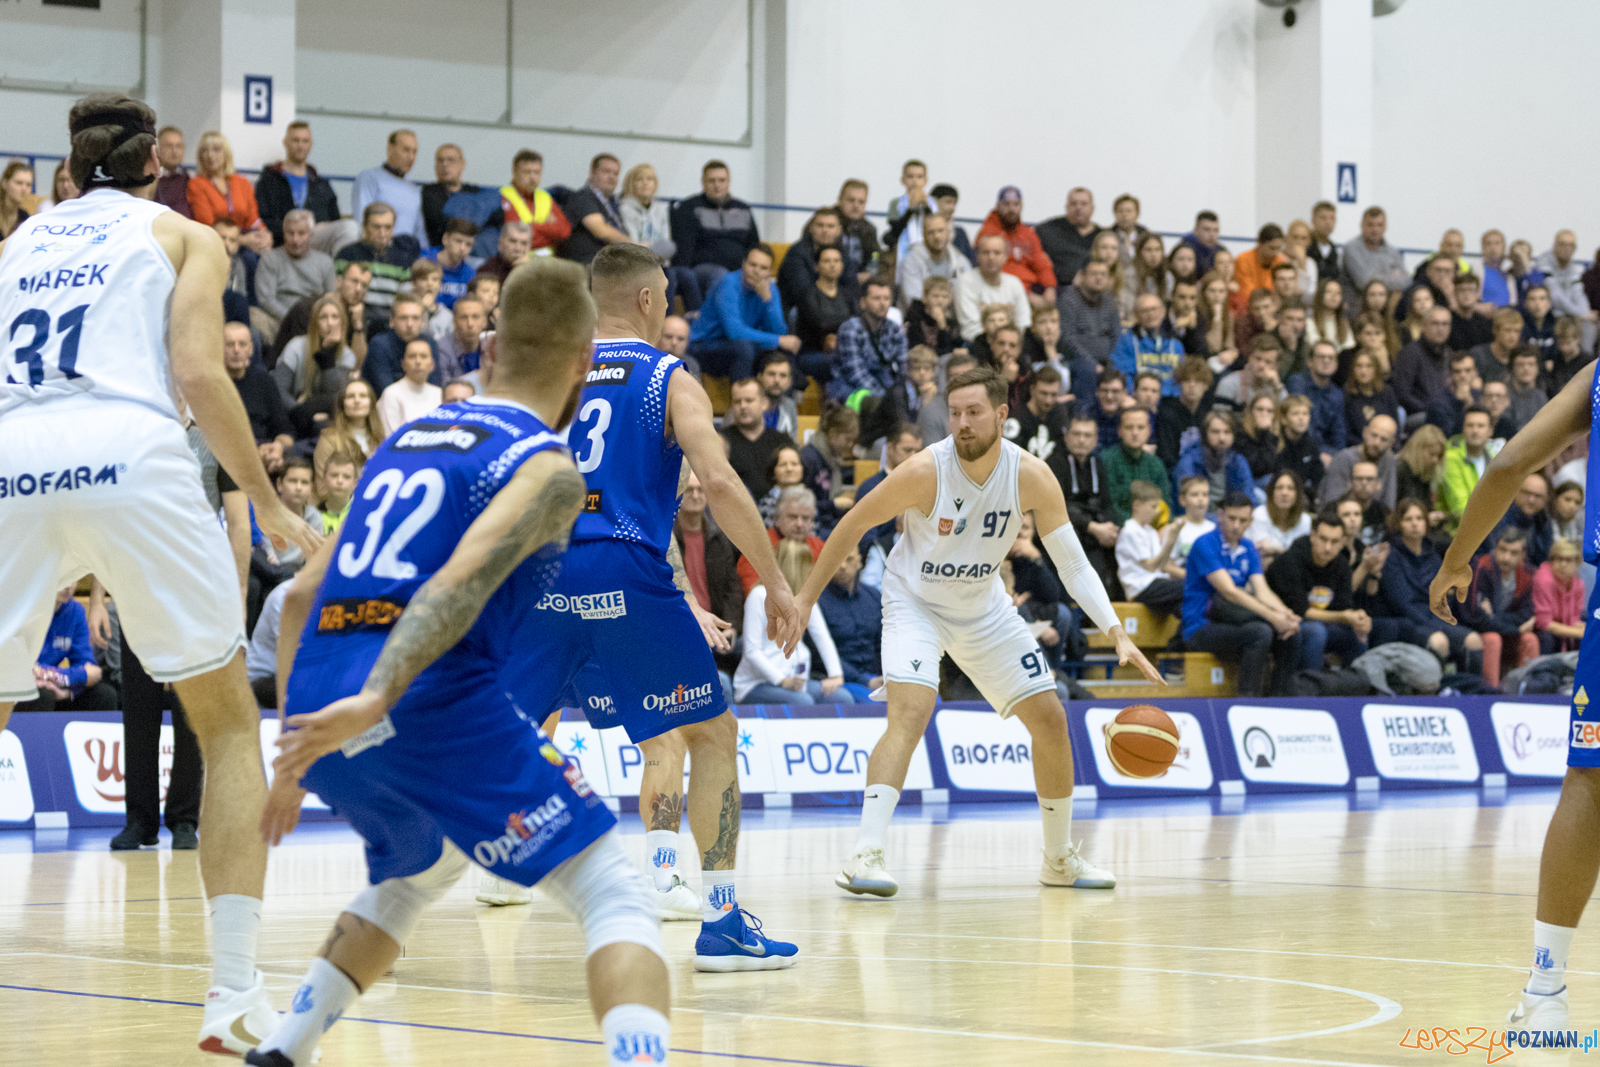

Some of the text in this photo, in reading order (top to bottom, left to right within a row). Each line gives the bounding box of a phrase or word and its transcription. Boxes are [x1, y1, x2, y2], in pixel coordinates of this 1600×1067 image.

[249, 82, 268, 118] B
[1340, 167, 1354, 199] A
[7, 304, 91, 388] 31
[598, 350, 653, 362] PRUDNIK
[575, 398, 612, 473] 3
[338, 468, 446, 580] 32
[981, 510, 1011, 538] 97
[921, 560, 1001, 578] BIOFAR
[538, 591, 624, 613] POLSKIE
[643, 682, 713, 711] Optima
[664, 696, 713, 715] MEDYCYNA
[1382, 716, 1451, 737] HELMEX
[1388, 741, 1455, 756] EXHIBITIONS
[474, 793, 568, 867] Optima
